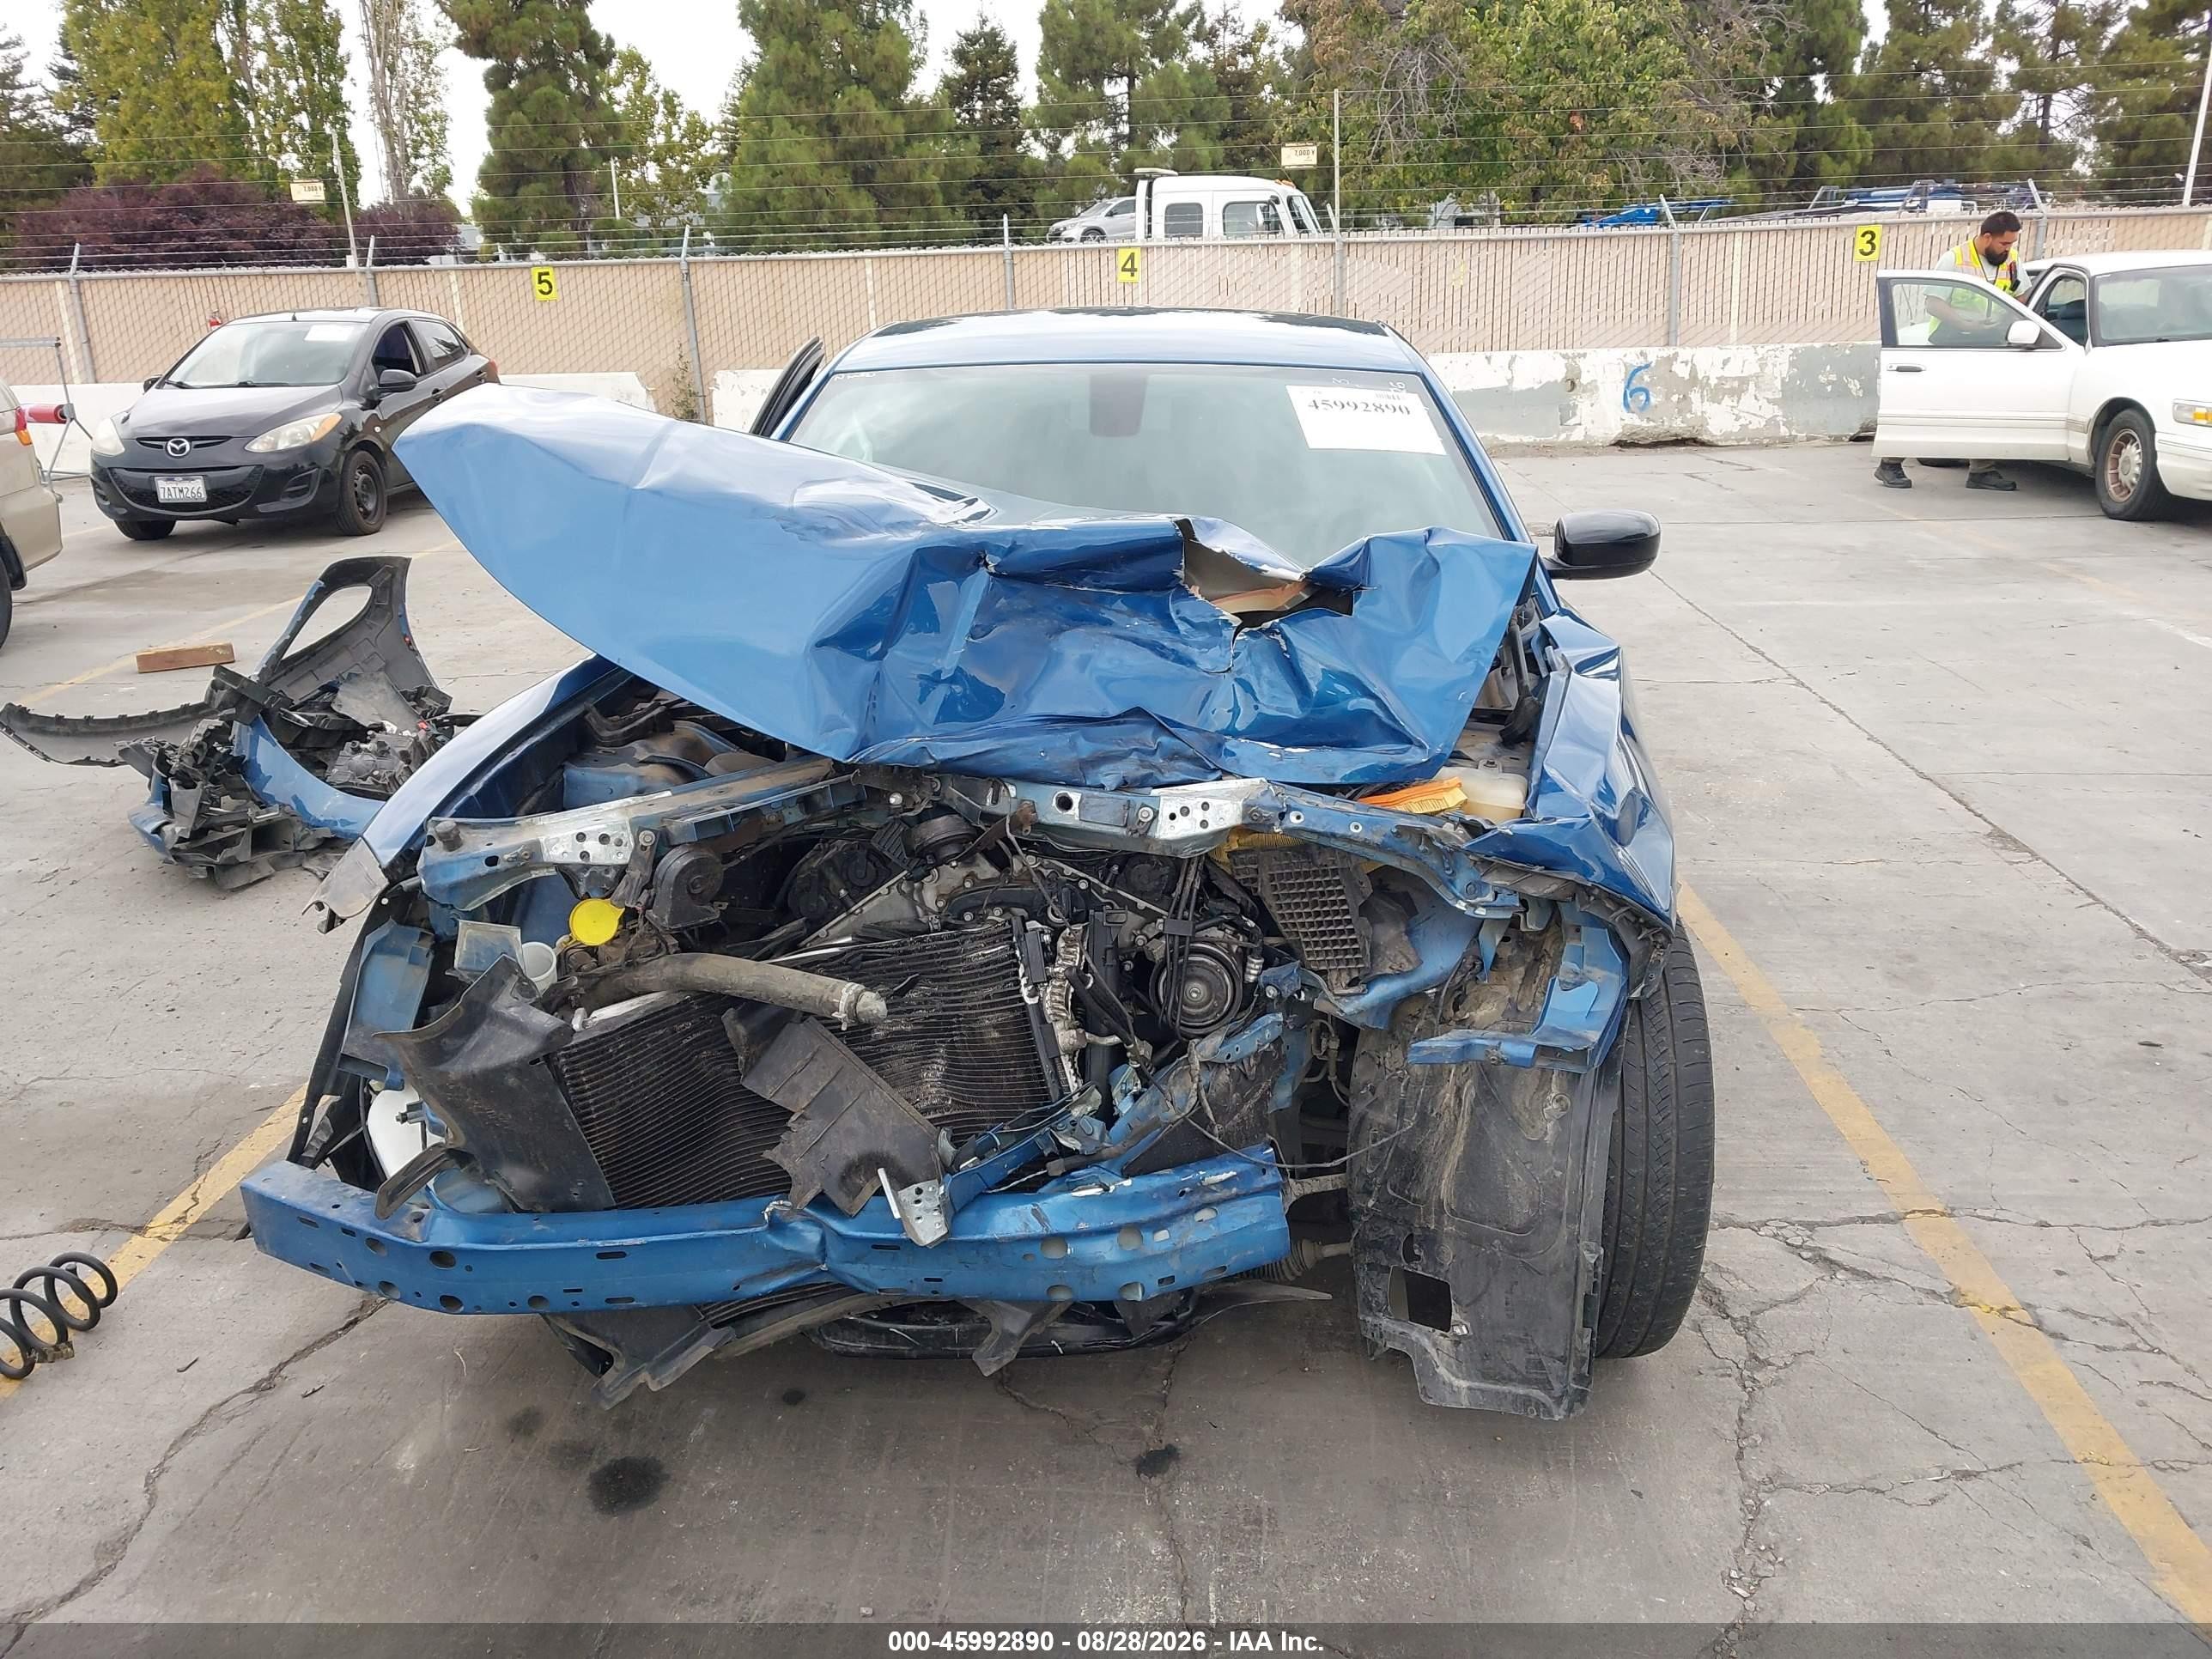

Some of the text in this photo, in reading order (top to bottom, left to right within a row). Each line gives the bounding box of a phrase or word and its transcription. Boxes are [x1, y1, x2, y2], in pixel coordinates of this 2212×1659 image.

[1858, 229, 1876, 257] 3
[1121, 252, 1138, 277] 4
[538, 270, 553, 295] 5
[1623, 361, 1653, 414] 6
[160, 486, 203, 499] 7ATM266
